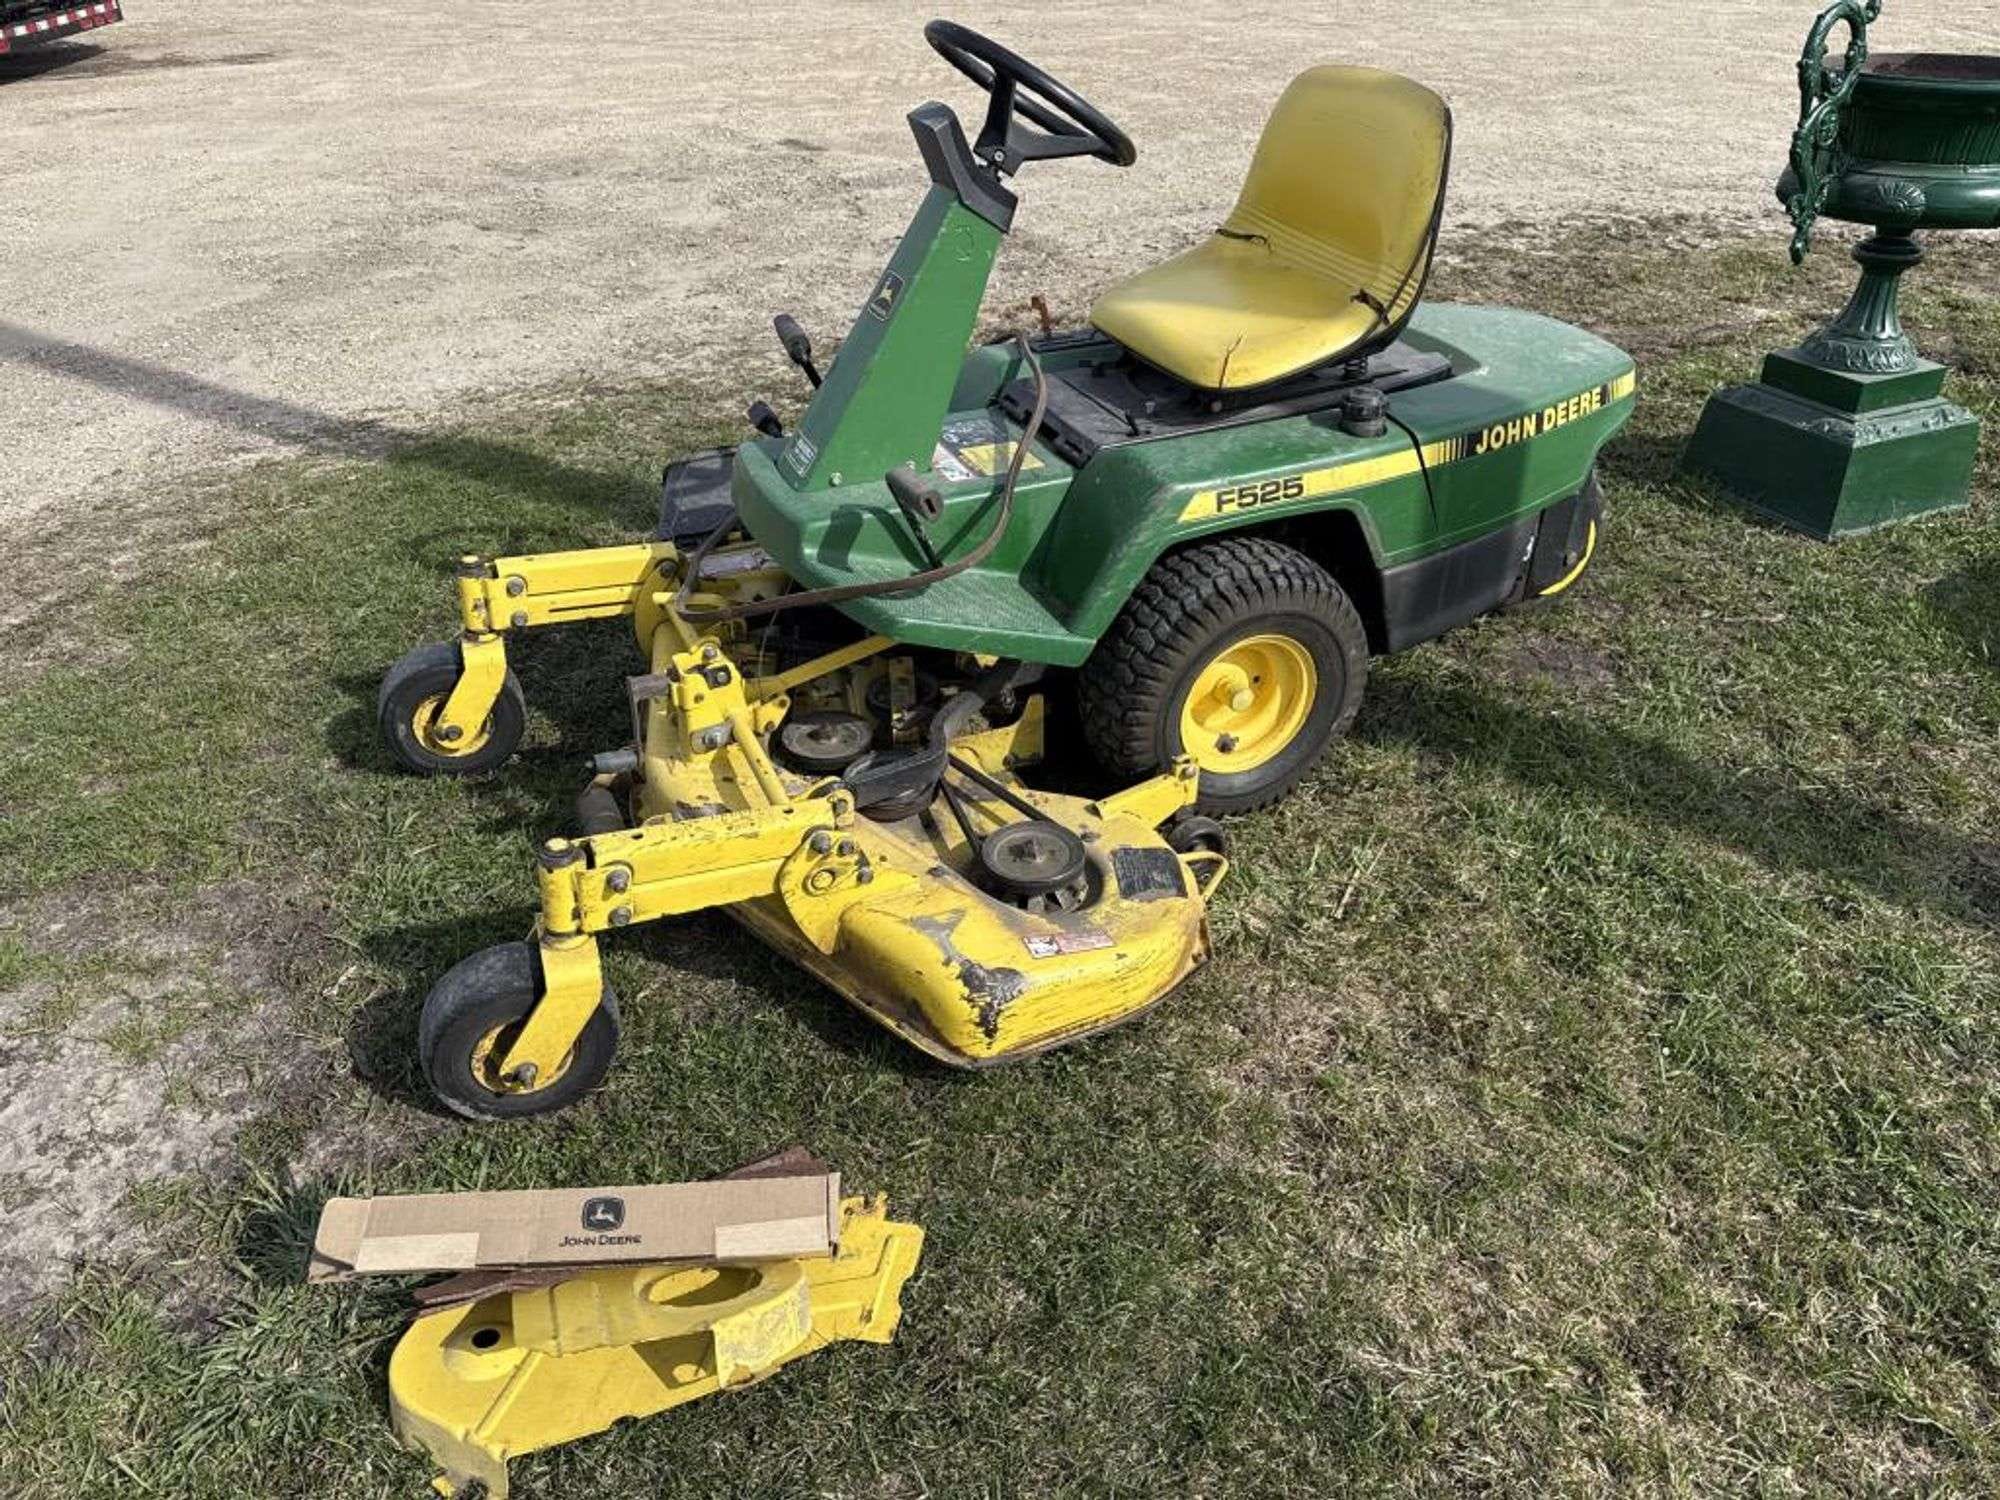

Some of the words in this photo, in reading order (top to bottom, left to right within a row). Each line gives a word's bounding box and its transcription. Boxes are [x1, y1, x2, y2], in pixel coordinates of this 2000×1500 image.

[1475, 414, 1537, 454] JOHN
[1542, 388, 1602, 431] DEERE
[1214, 476, 1304, 513] F525
[559, 1235, 597, 1248] JOHN
[598, 1234, 643, 1246] DEERE
